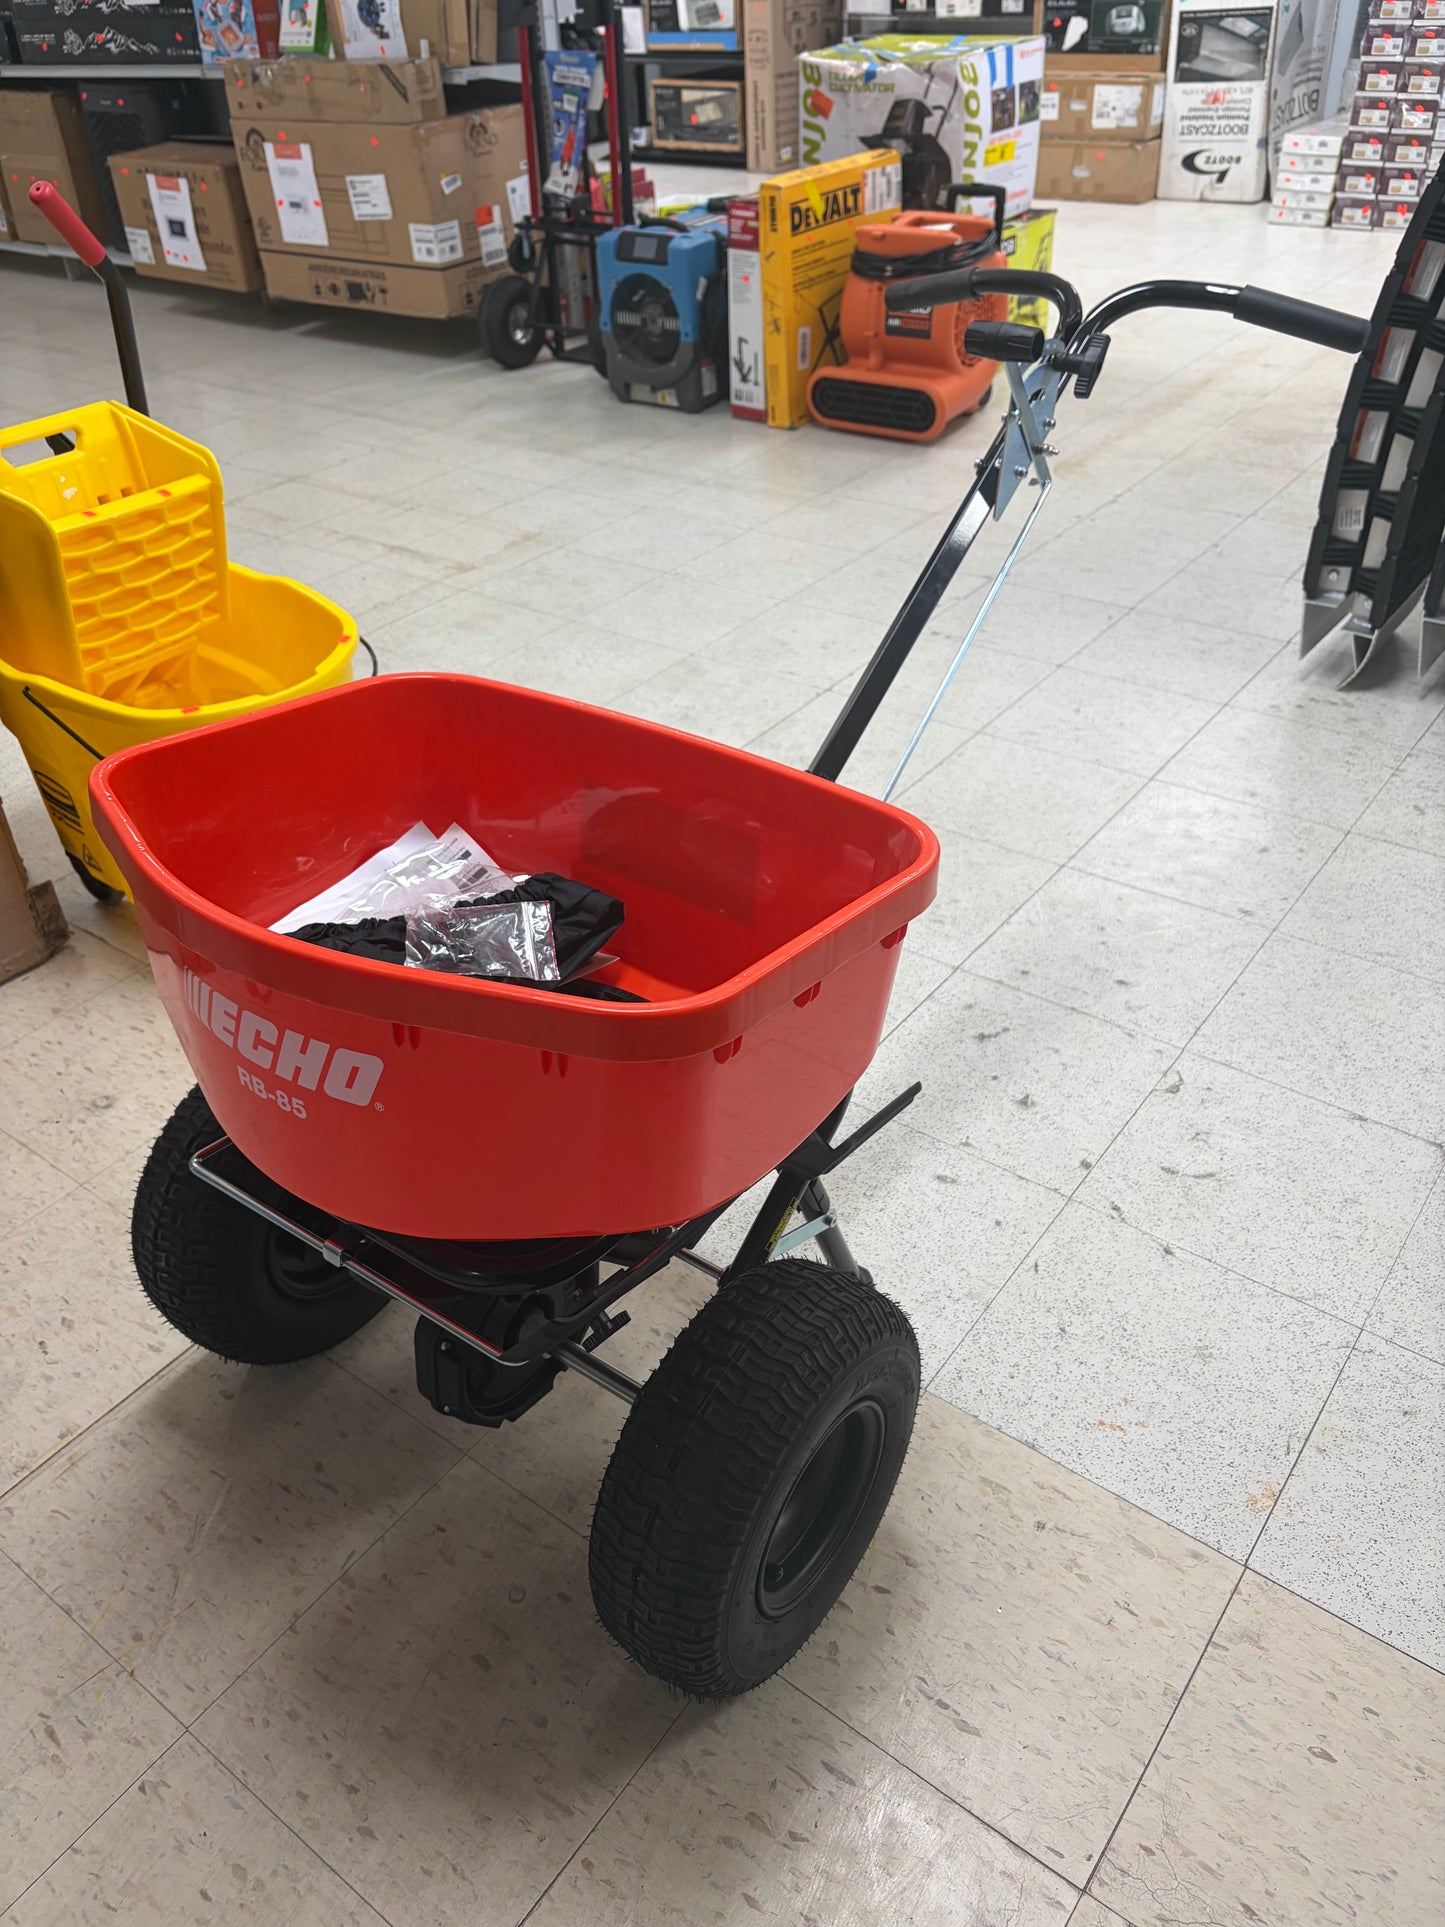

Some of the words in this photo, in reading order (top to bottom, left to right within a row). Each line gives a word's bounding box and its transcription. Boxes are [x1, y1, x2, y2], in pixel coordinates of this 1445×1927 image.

[1179, 123, 1250, 136] BOOTZCAST
[1204, 155, 1242, 164] BOOTZ
[211, 991, 384, 1107] ECHO
[237, 1065, 307, 1120] RB-85
